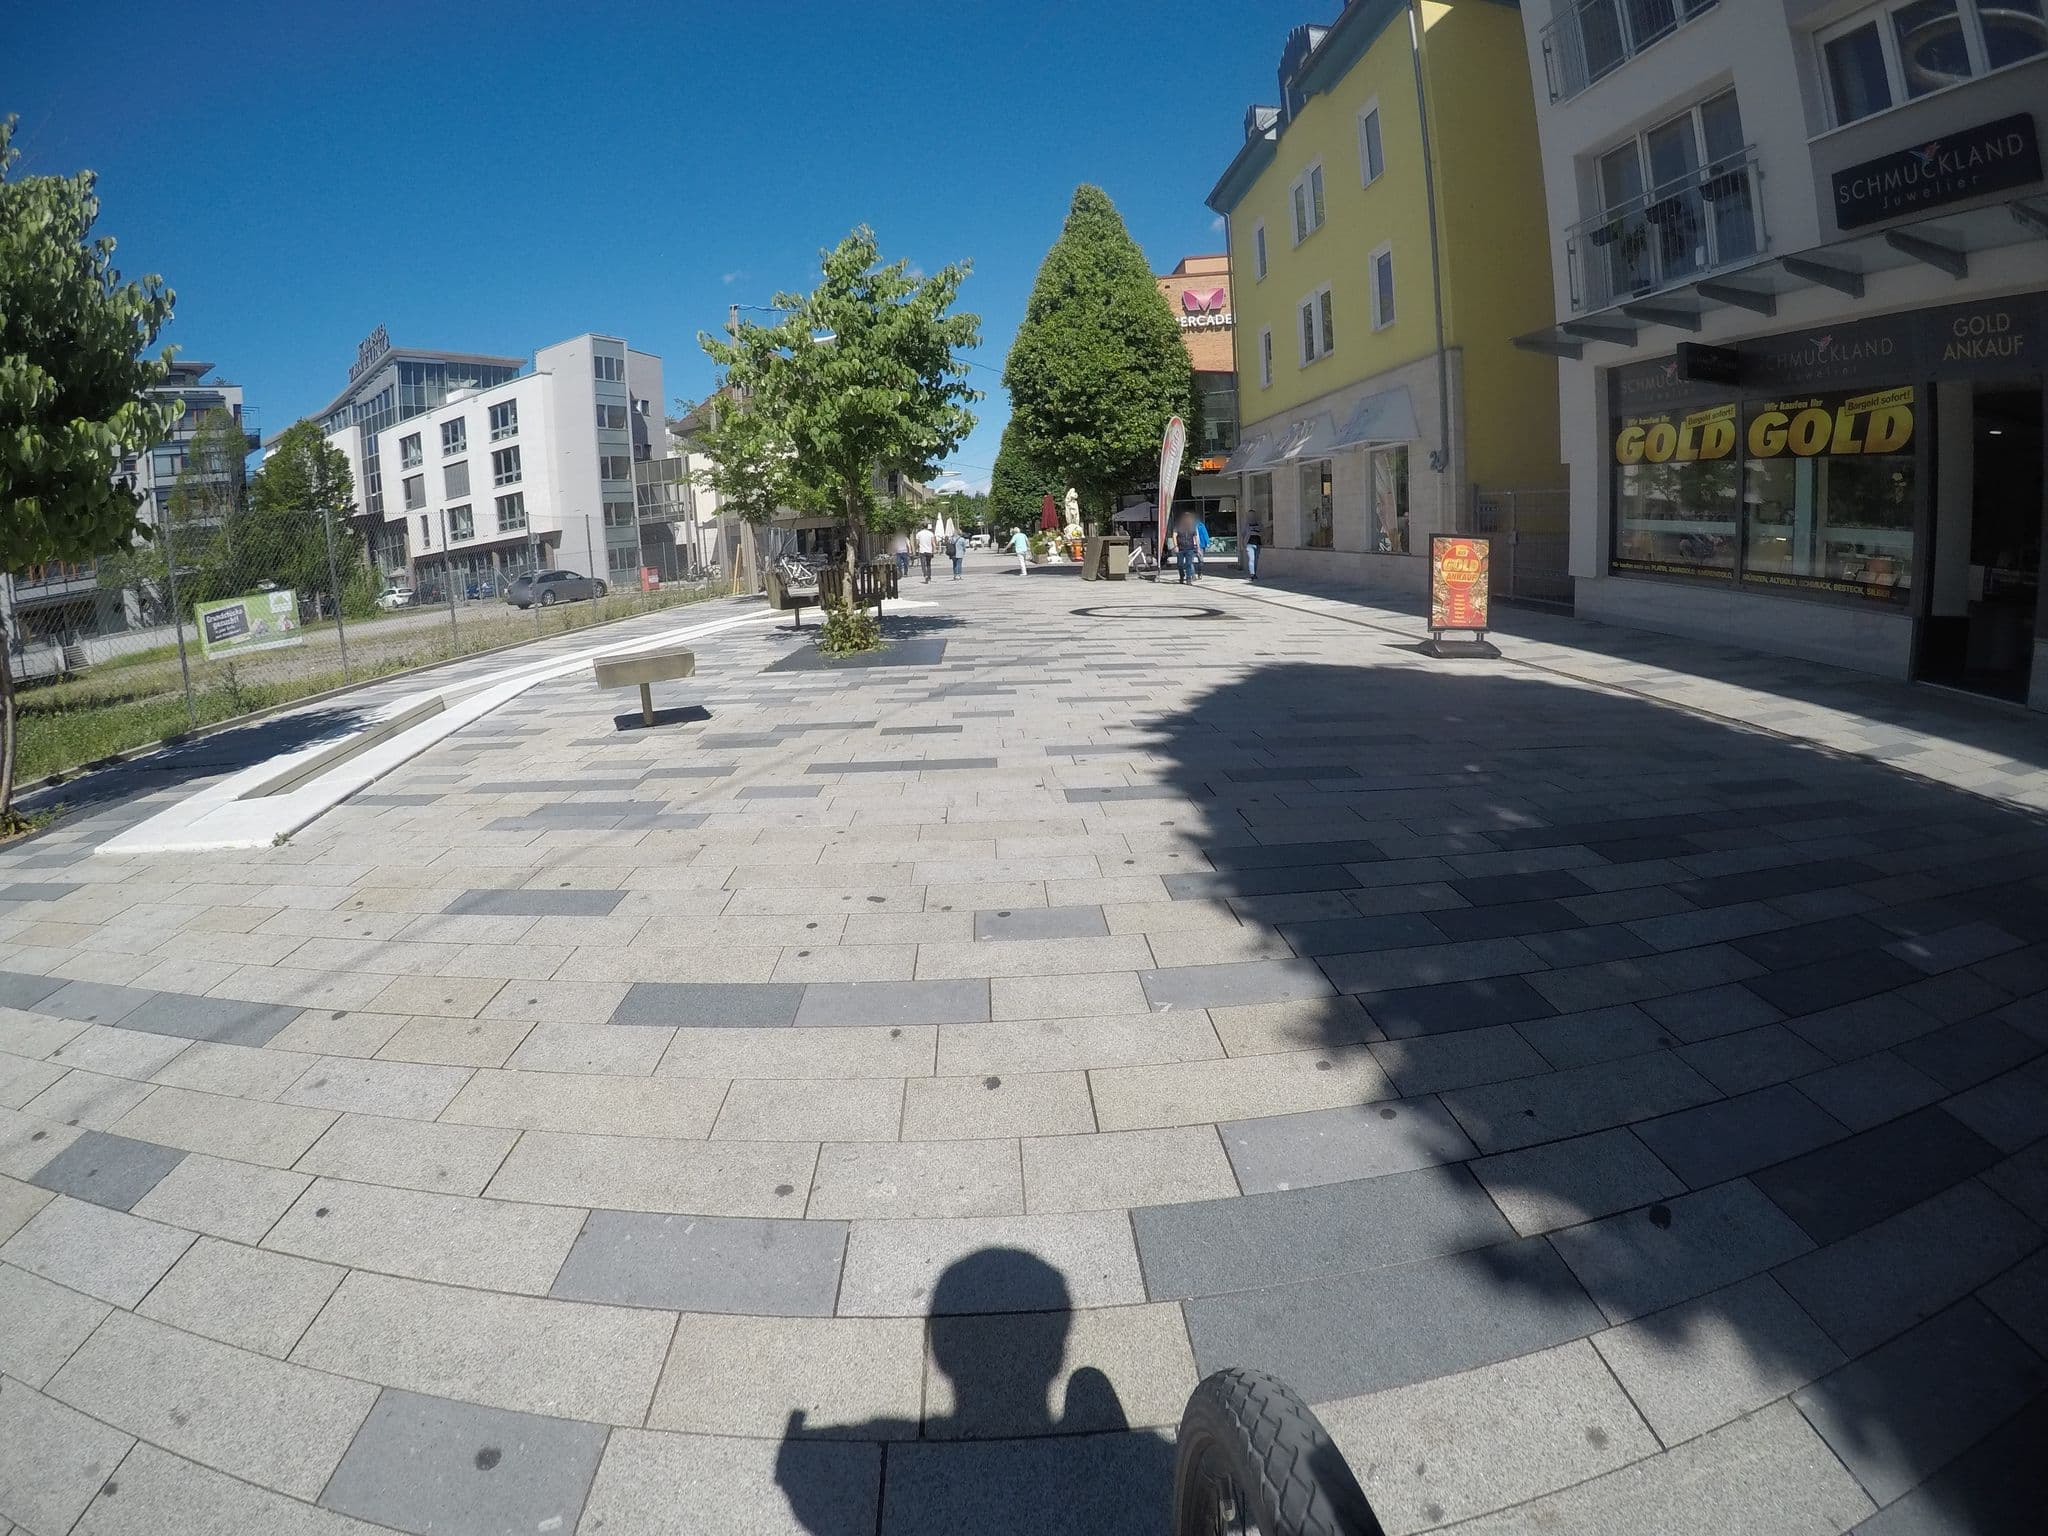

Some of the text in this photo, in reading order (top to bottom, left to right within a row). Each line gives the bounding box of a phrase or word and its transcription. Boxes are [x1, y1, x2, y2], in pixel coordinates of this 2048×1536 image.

[1838, 133, 2025, 204] SCHMUCKLAND
[1952, 313, 2010, 337] GOLD
[1943, 335, 2024, 361] ANKAUF
[1764, 402, 1778, 411] Wir
[1779, 400, 1808, 410] kaufen
[1848, 390, 1911, 411] Bargeld sofort!
[1711, 407, 1734, 418] sofort!
[1616, 420, 1736, 465] GOLD
[1748, 406, 1914, 458] GOLD
[1443, 558, 1480, 571] GOLD
[1446, 572, 1477, 581] ANKAUF
